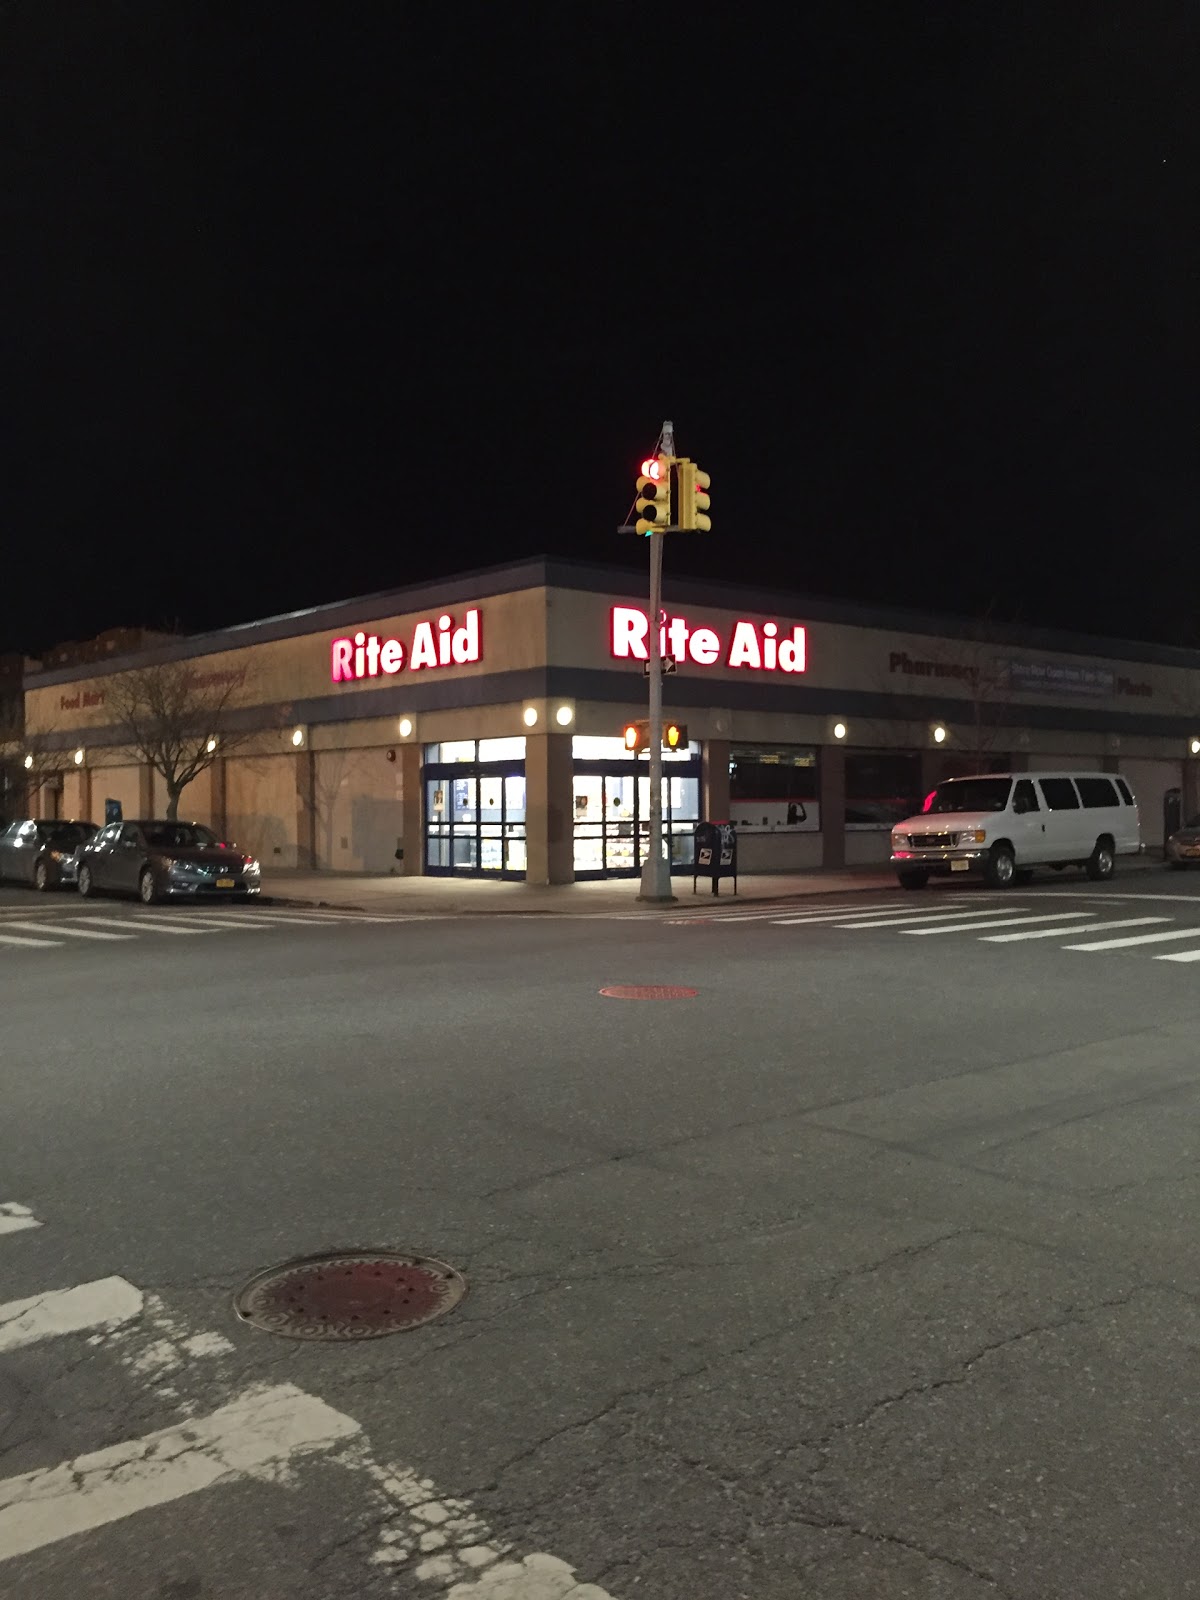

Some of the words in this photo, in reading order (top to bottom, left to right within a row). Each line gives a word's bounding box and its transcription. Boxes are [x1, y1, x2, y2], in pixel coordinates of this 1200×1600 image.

[331, 631, 406, 683] Rite
[409, 608, 483, 672] Aid
[728, 620, 806, 674] Aid
[889, 651, 979, 680] Pharmacy
